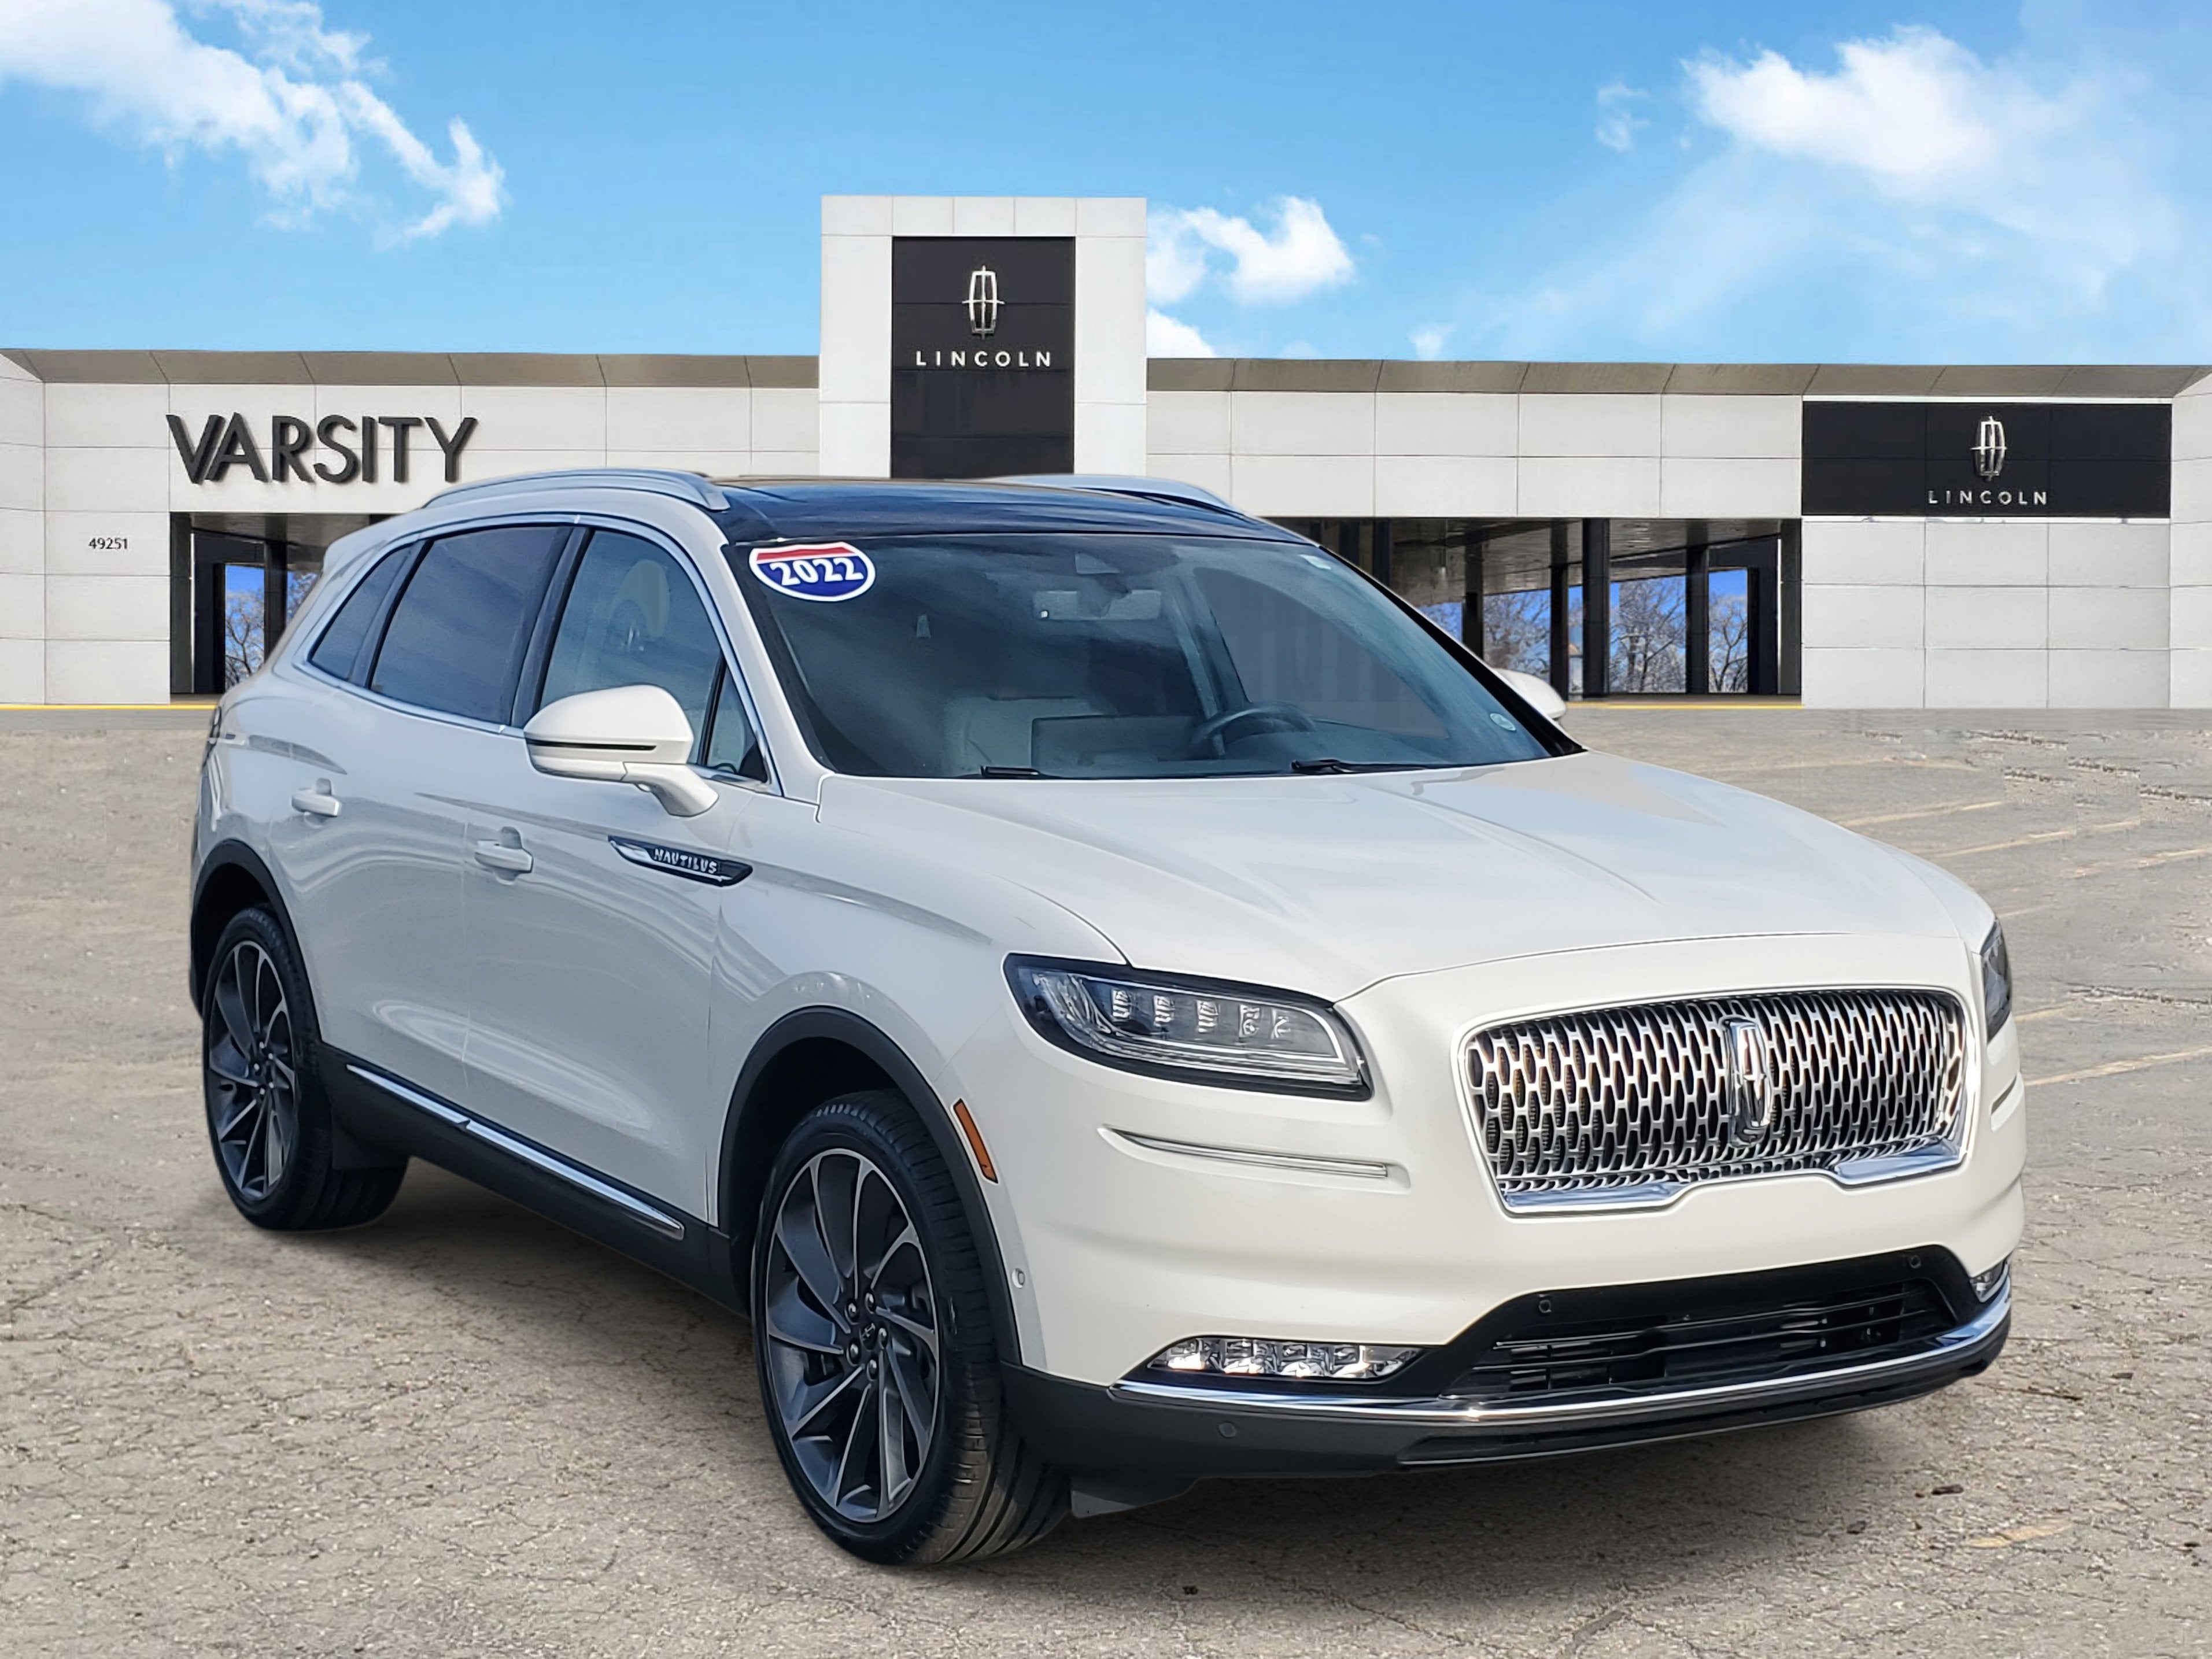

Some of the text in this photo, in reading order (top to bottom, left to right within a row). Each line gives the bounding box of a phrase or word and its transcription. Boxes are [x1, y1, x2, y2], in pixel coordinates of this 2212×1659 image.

[916, 350, 1051, 367] LINCOLN
[166, 412, 478, 484] VARSITY
[1928, 490, 2047, 505] LINCOLN
[88, 537, 128, 550] 49251
[769, 557, 865, 586] 2022
[653, 848, 717, 874] NAUTILUS
